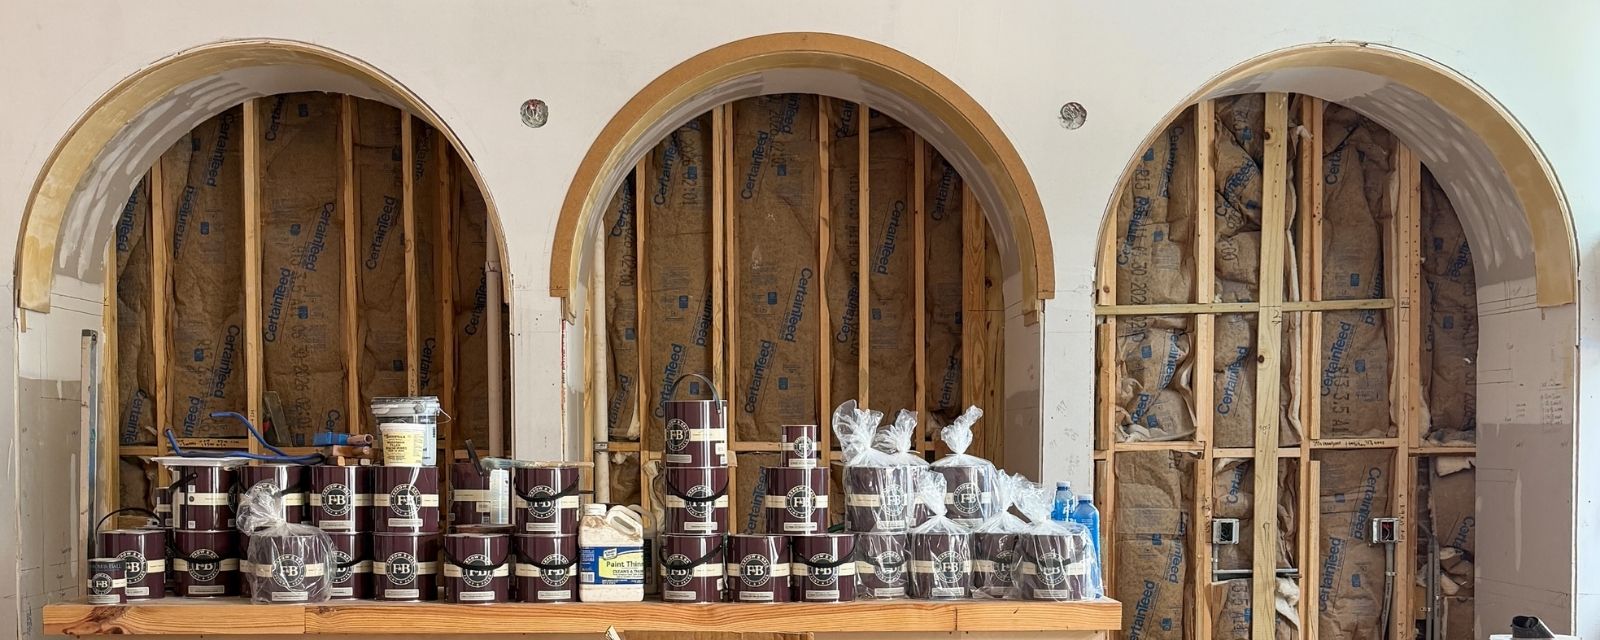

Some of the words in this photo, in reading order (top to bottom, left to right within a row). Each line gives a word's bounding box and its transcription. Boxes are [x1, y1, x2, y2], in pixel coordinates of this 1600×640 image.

[207, 113, 234, 188] CertainTeed
[741, 130, 768, 200] CertainTeed
[302, 201, 335, 272] CertainTeed
[877, 200, 905, 275] CertainTeed
[264, 267, 291, 342] CertainTeed
[785, 267, 812, 343] CertainTeed
[214, 324, 240, 399] CertainTeed
[745, 339, 772, 414] CertainTeed
[1217, 346, 1250, 415] CertainTeed
[1321, 321, 1352, 397] CertainTeed
[1354, 467, 1381, 540] CertainTeed
